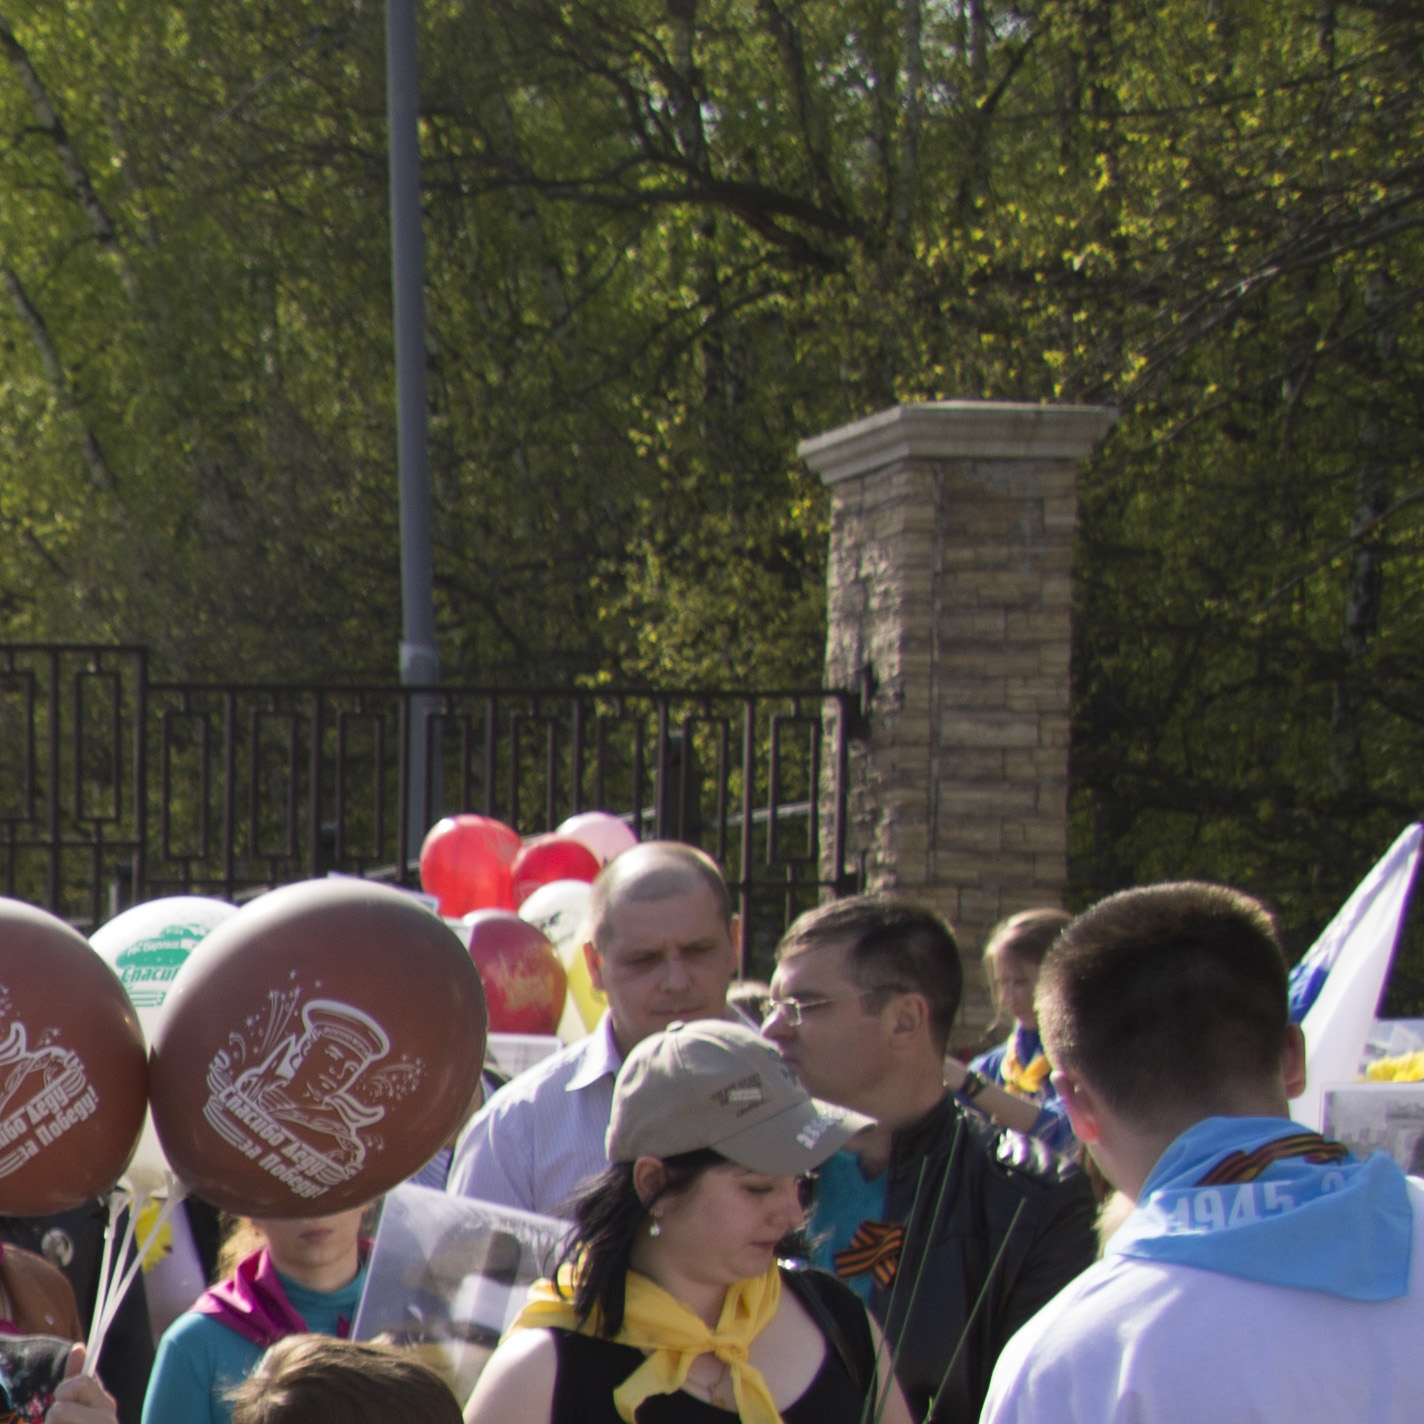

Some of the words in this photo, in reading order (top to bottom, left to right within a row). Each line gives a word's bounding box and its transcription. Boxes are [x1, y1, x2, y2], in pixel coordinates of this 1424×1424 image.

[17, 1139, 41, 1161] за
[34, 1084, 100, 1148] Победу!
[24, 1085, 70, 1126] Деду
[218, 1085, 287, 1148] Спасибо
[280, 1140, 328, 1181] Деду
[237, 1138, 264, 1161] за
[258, 1152, 331, 1199] Победу!
